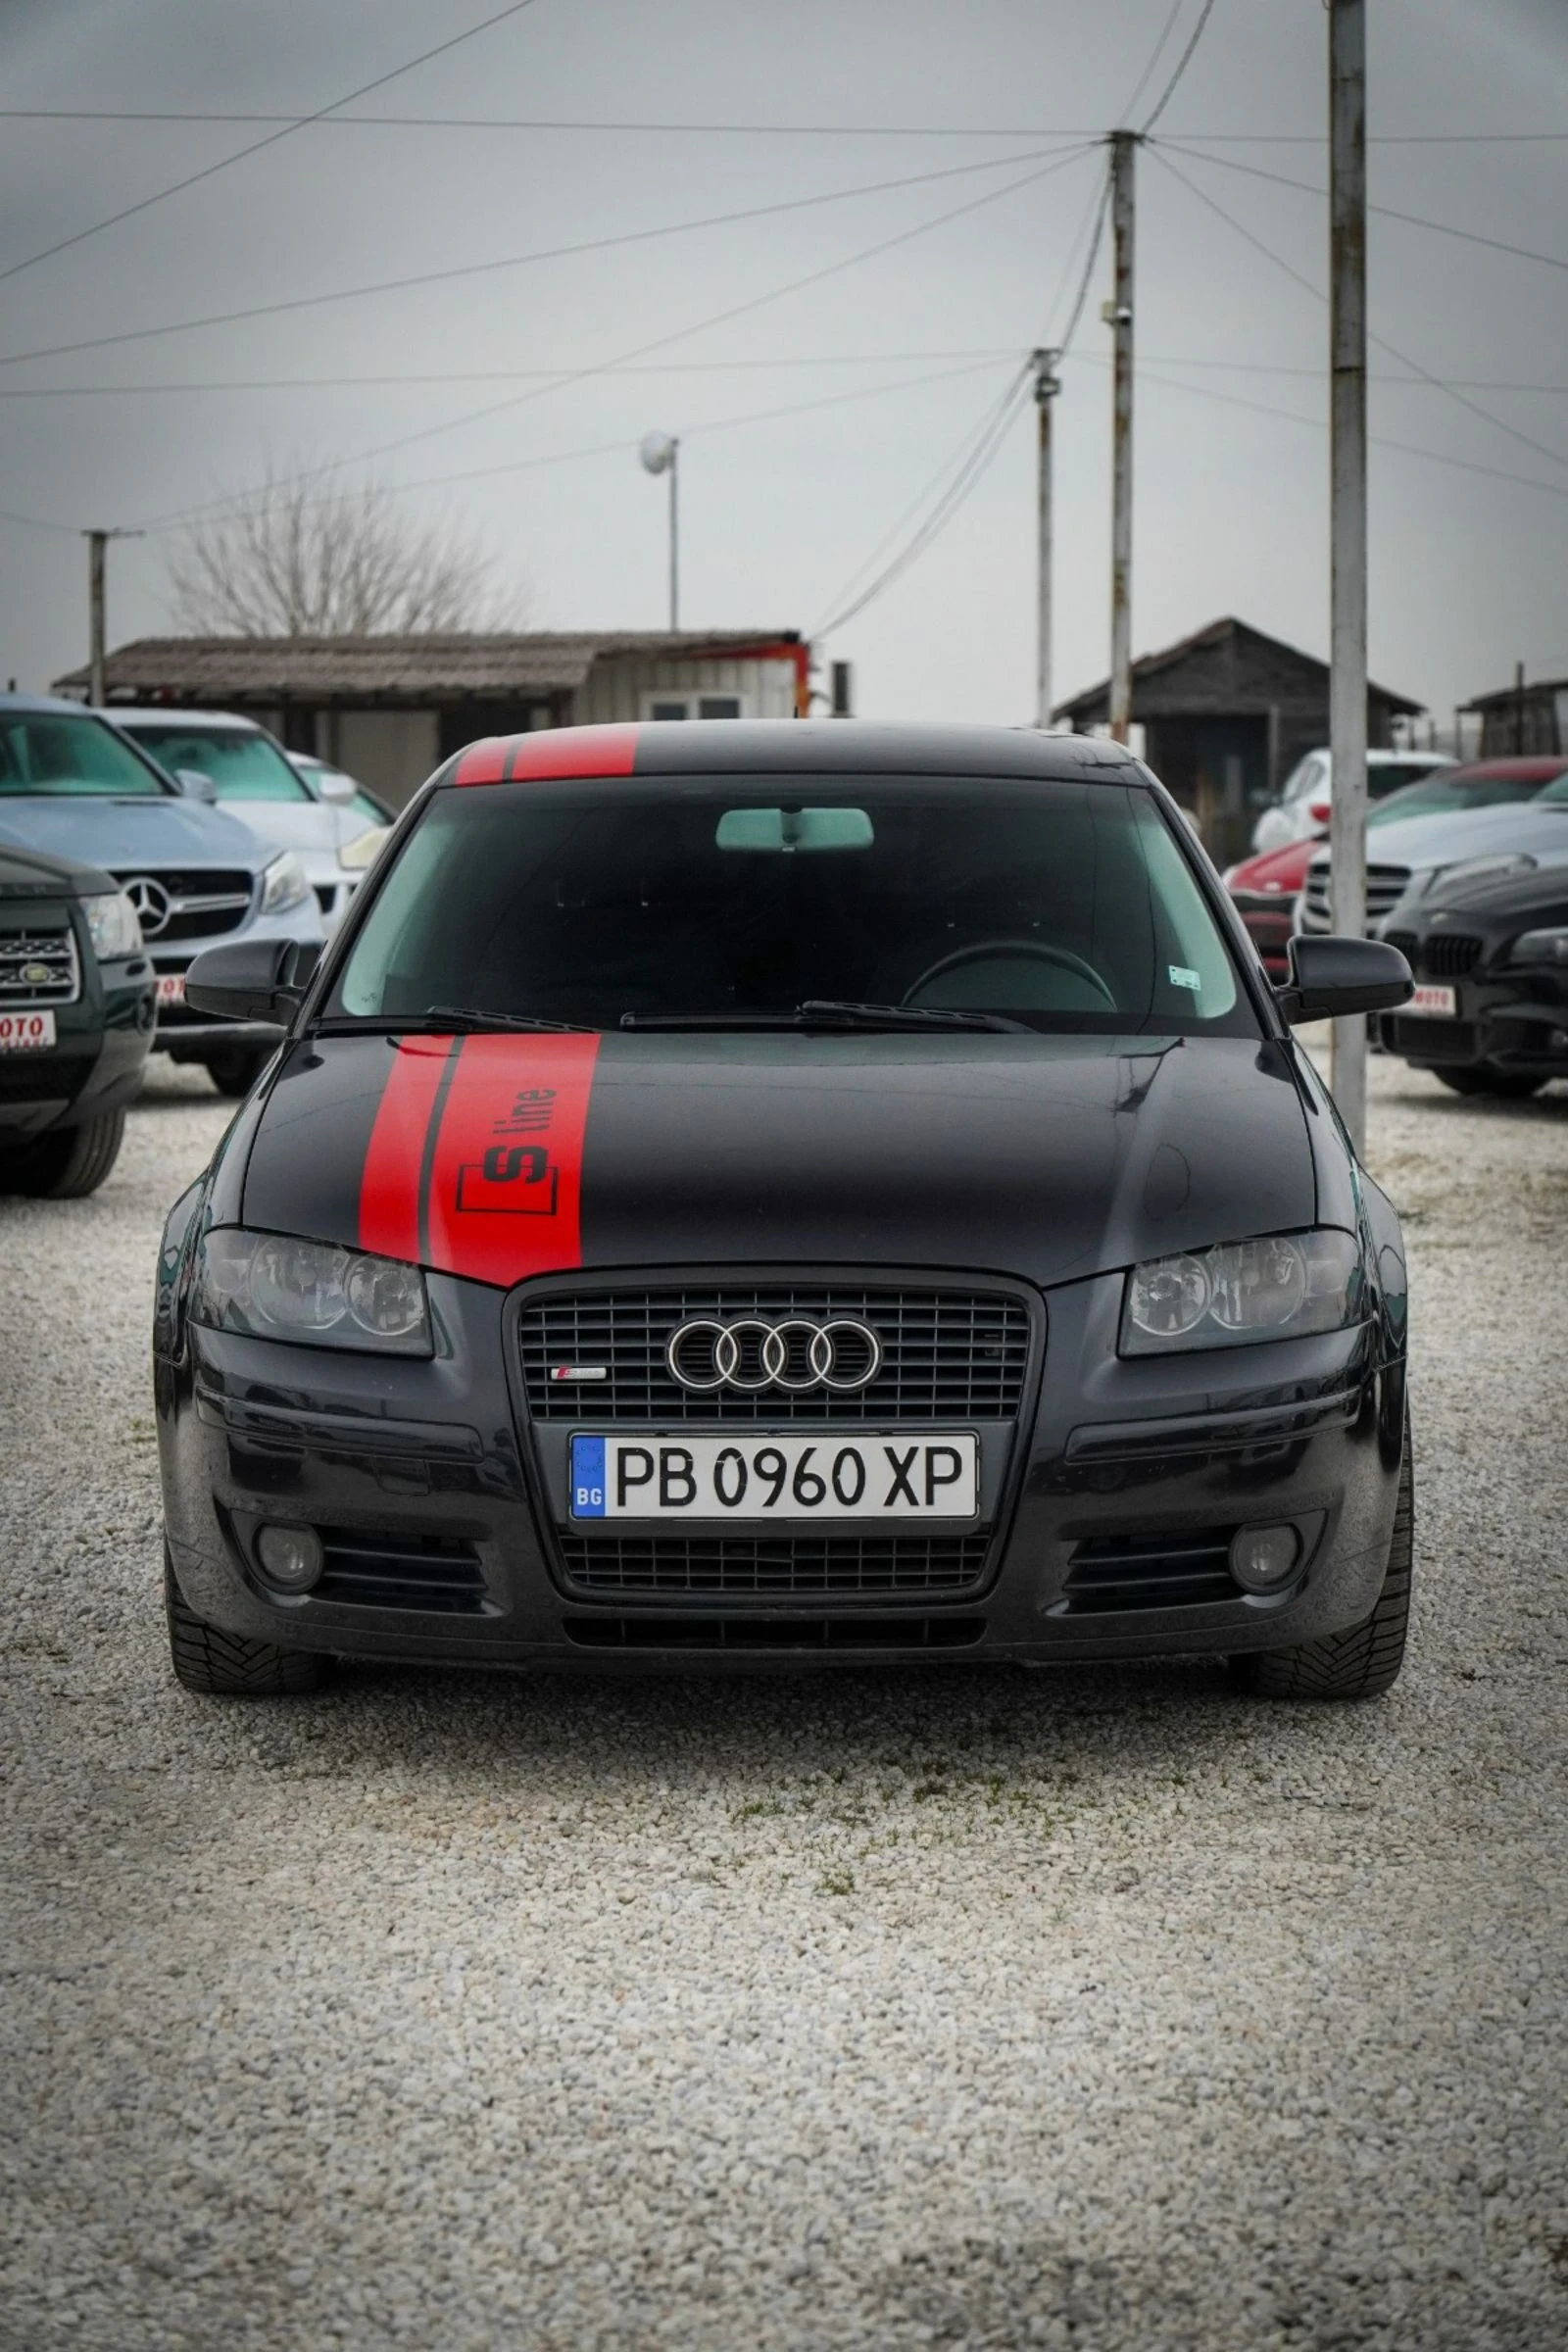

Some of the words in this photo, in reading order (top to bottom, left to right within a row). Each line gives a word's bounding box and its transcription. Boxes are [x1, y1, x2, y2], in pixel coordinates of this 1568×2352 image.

[492, 1089, 557, 1134] line
[483, 1146, 547, 1184] S
[576, 1487, 602, 1506] BG
[616, 1447, 698, 1507] PB
[713, 1446, 866, 1507] 0960
[883, 1446, 963, 1507] XP
